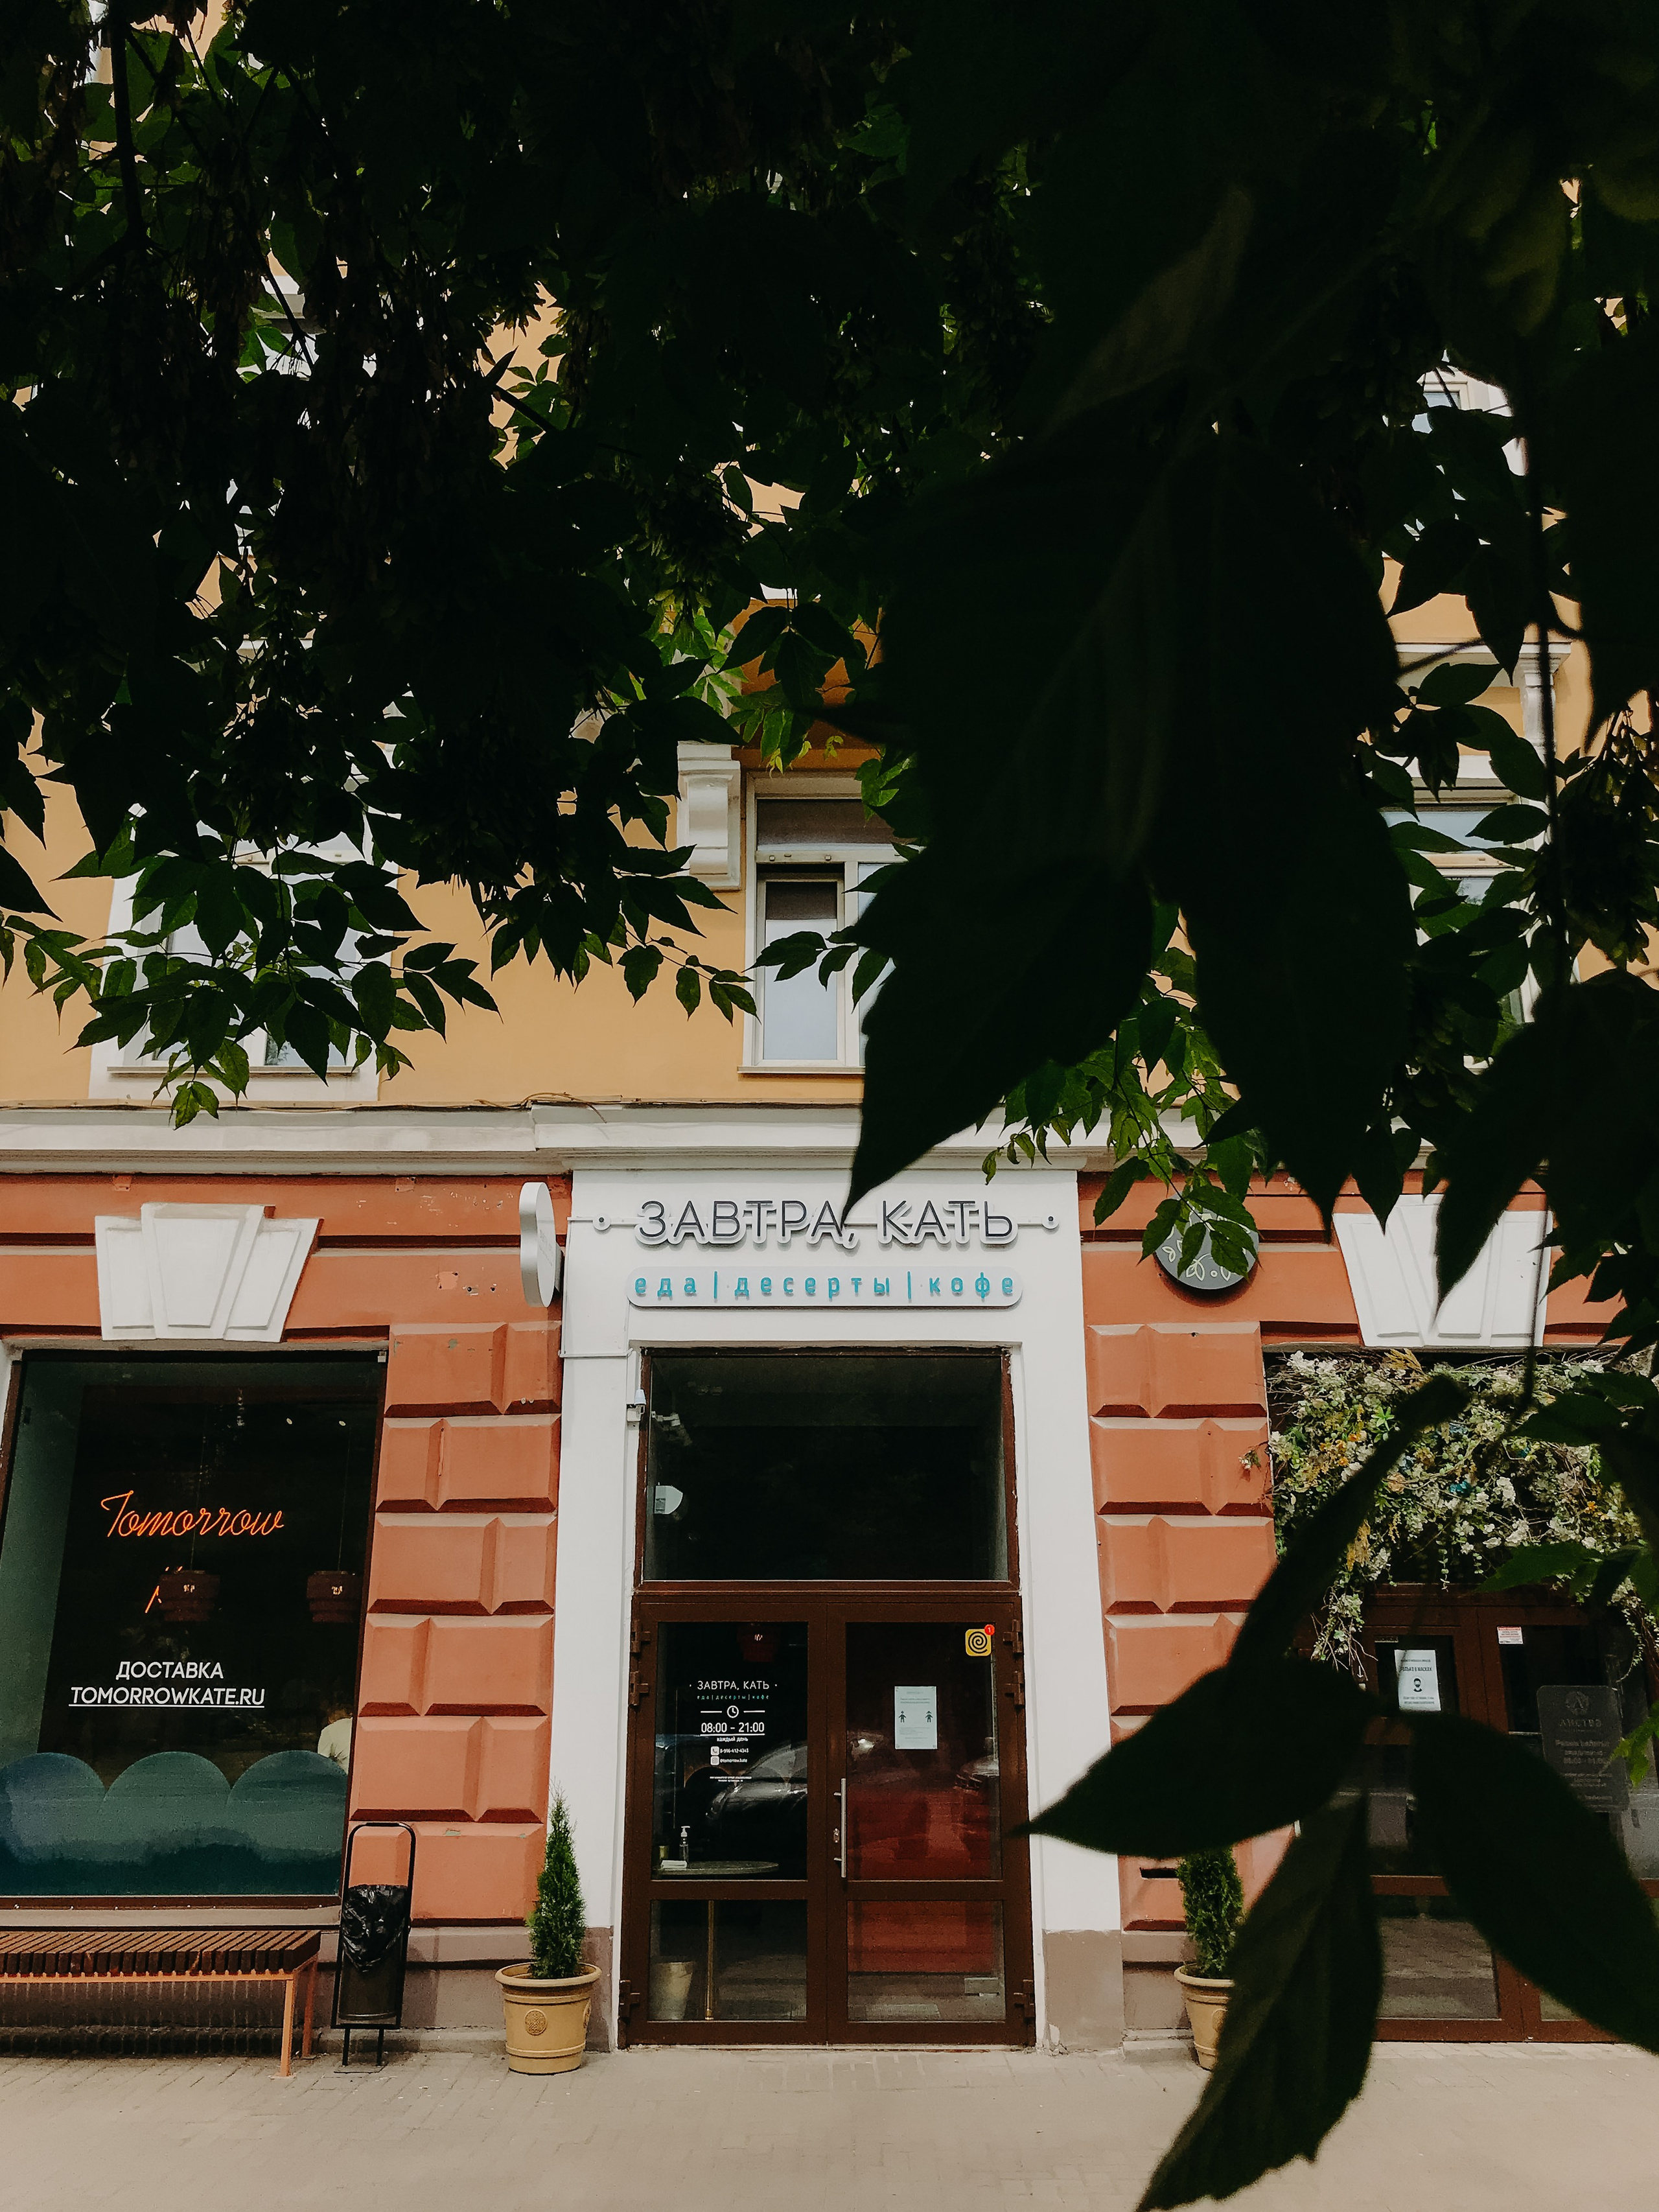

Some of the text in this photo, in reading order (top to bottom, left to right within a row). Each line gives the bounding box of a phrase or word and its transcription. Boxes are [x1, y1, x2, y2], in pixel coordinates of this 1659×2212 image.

[638, 1200, 1014, 1242] ЗАВТРА, КАТЬ
[634, 1272, 1014, 1299] еда десерты кофе
[100, 1490, 284, 1537] Tomorrow
[115, 1661, 224, 1680] ДОСТАВКА
[697, 1681, 769, 1690] ЗАВТРА, КАТЬ
[71, 1687, 265, 1705] TOMORROWKATE.RU
[701, 1723, 727, 1733] 08:00
[739, 1722, 765, 1732] 21:00
